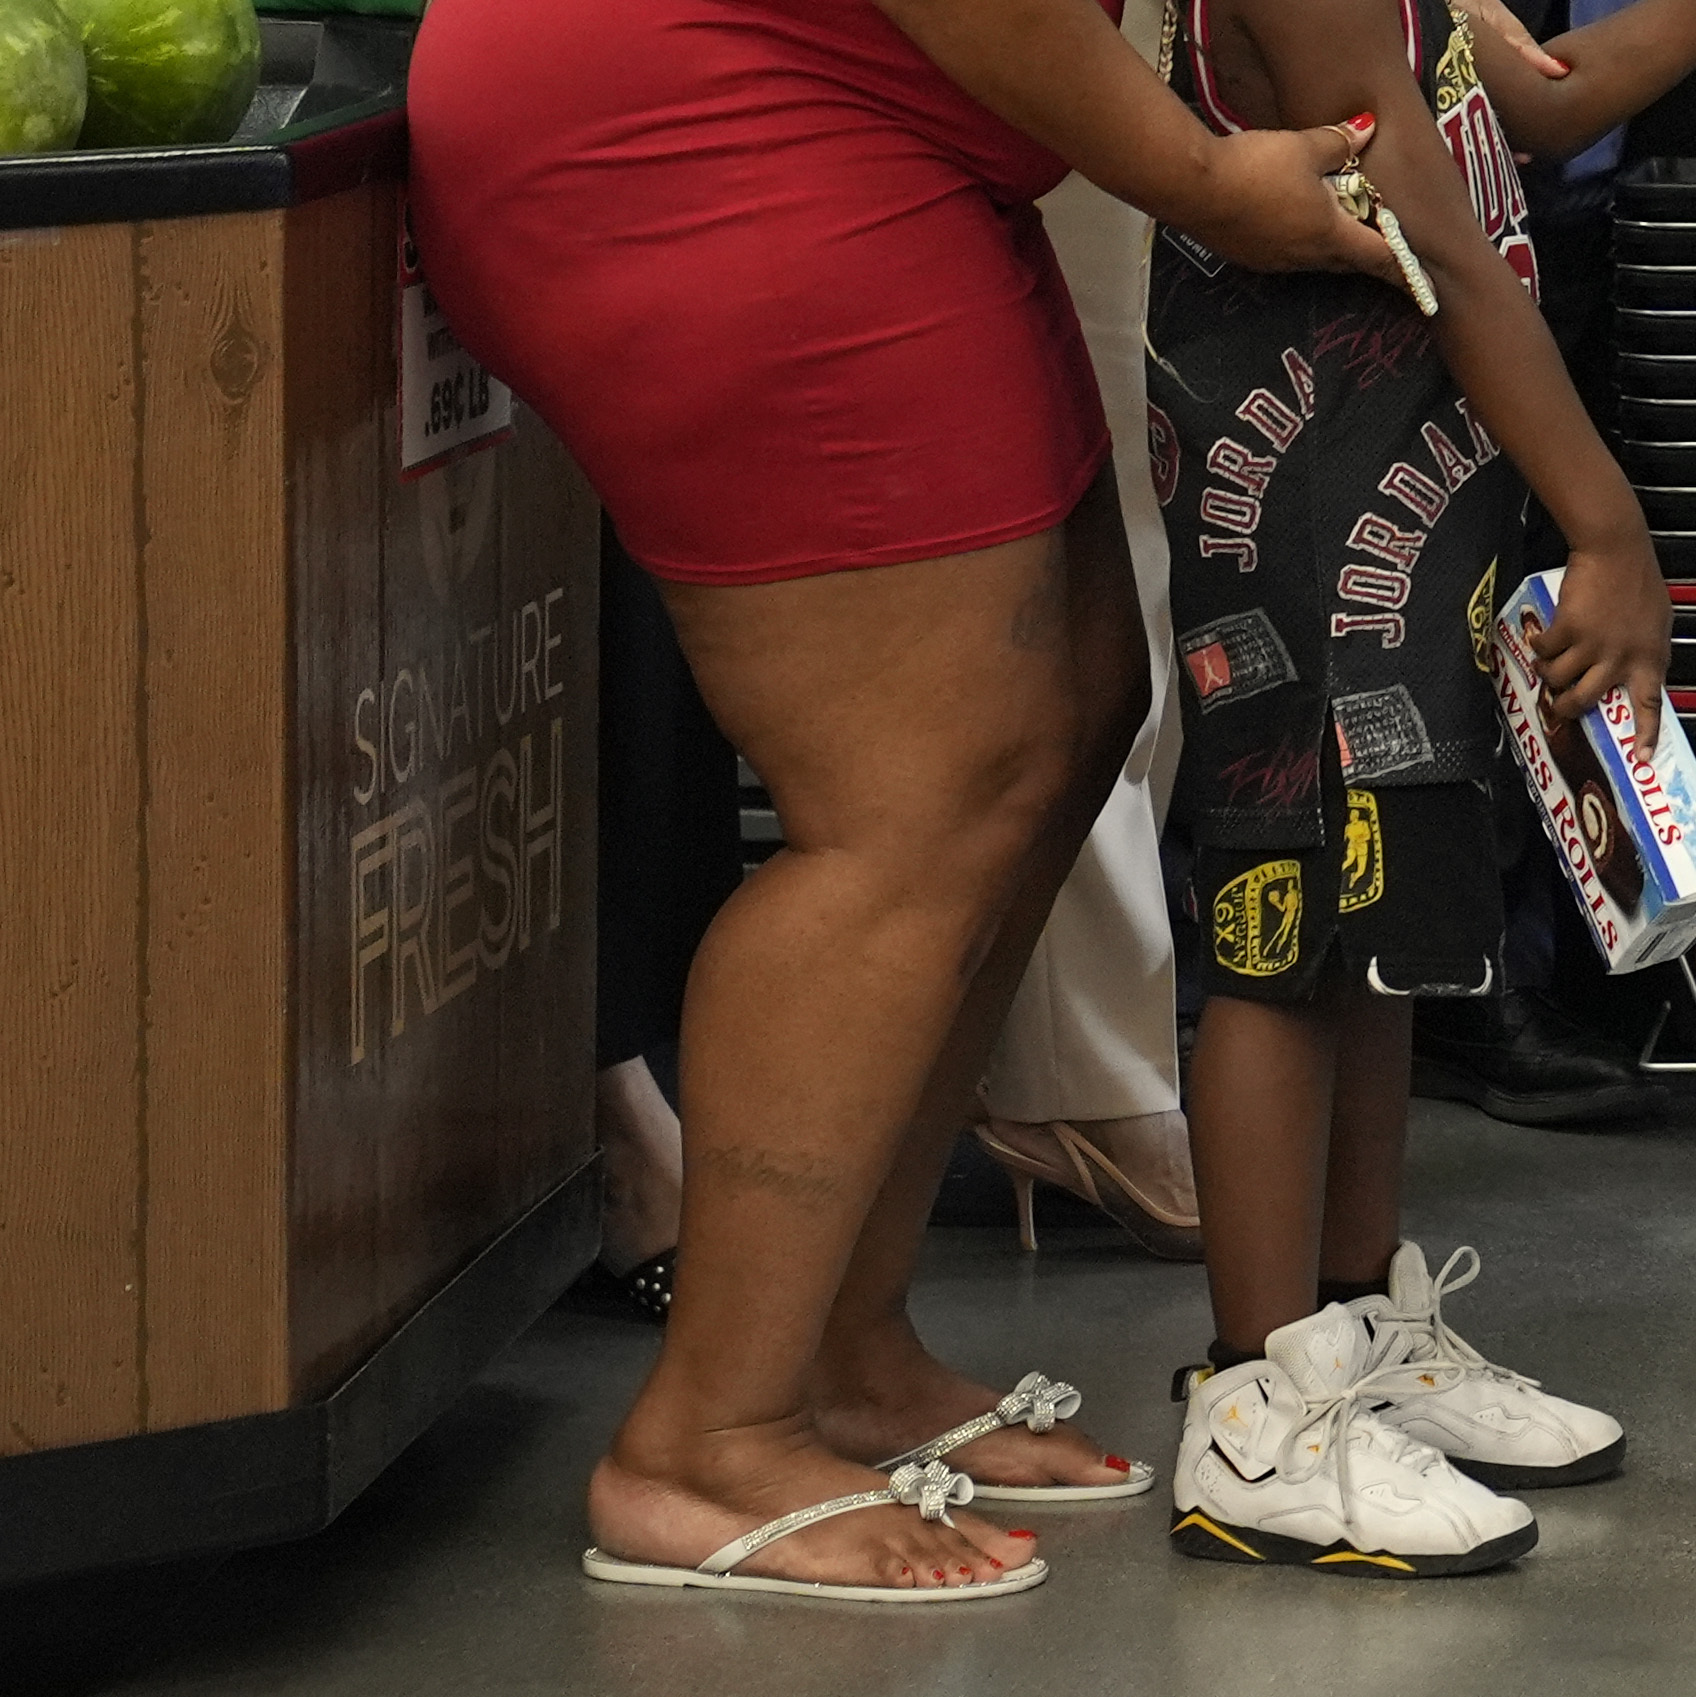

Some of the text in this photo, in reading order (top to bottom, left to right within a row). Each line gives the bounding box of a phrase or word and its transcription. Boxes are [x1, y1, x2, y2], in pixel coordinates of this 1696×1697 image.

[1200, 347, 1316, 573] JORDA
[354, 588, 563, 804] SIGNATURE
[1489, 643, 1553, 792] SWISS
[1551, 795, 1619, 951] ROLLS
[351, 717, 562, 1066] FRESH
